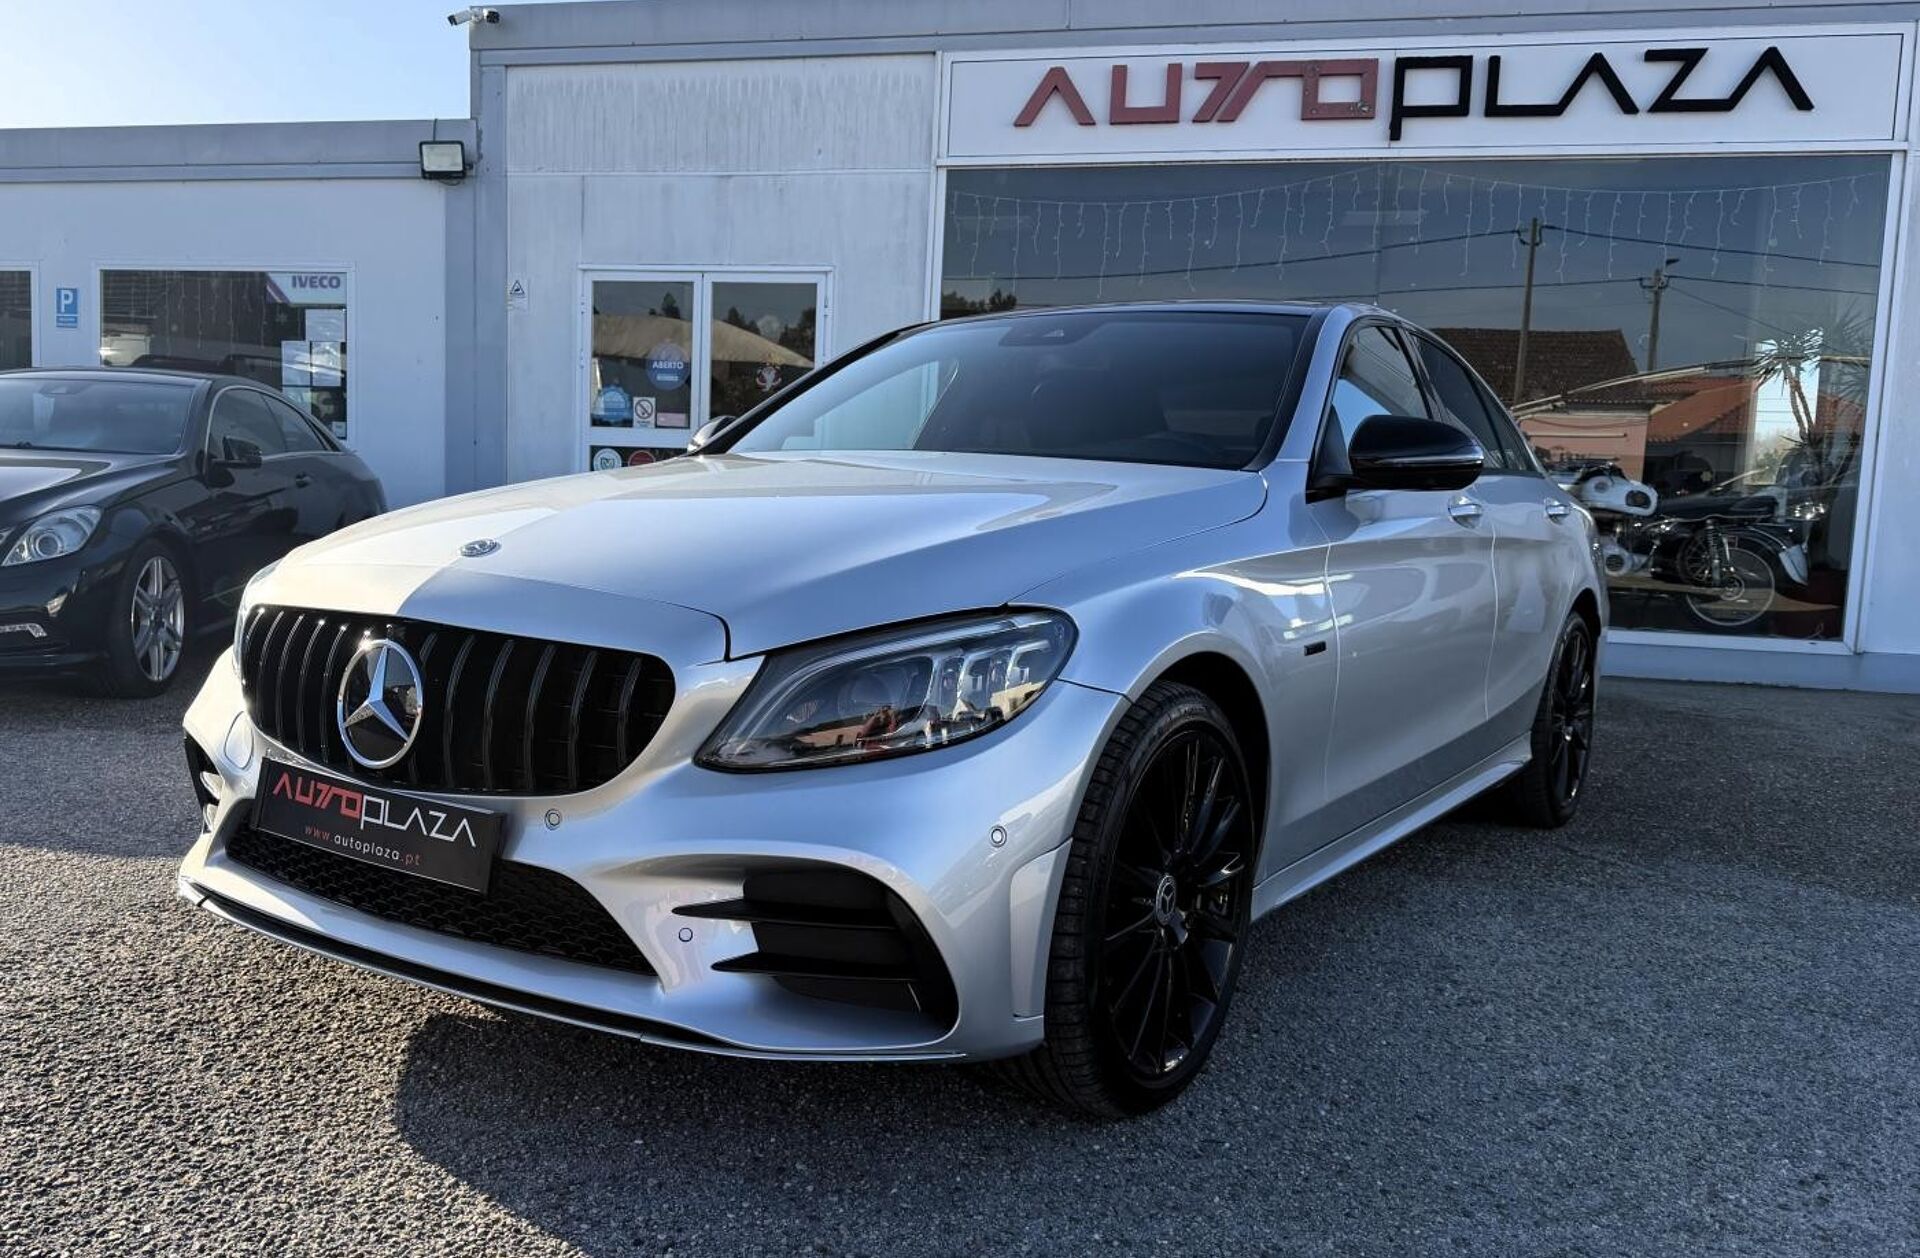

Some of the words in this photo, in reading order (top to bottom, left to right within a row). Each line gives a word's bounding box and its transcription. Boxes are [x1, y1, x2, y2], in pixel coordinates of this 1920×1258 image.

[292, 275, 341, 289] IVECO
[60, 290, 74, 313] P
[652, 361, 684, 369] ABERTO
[305, 825, 421, 866] www.autoplaza.pt
